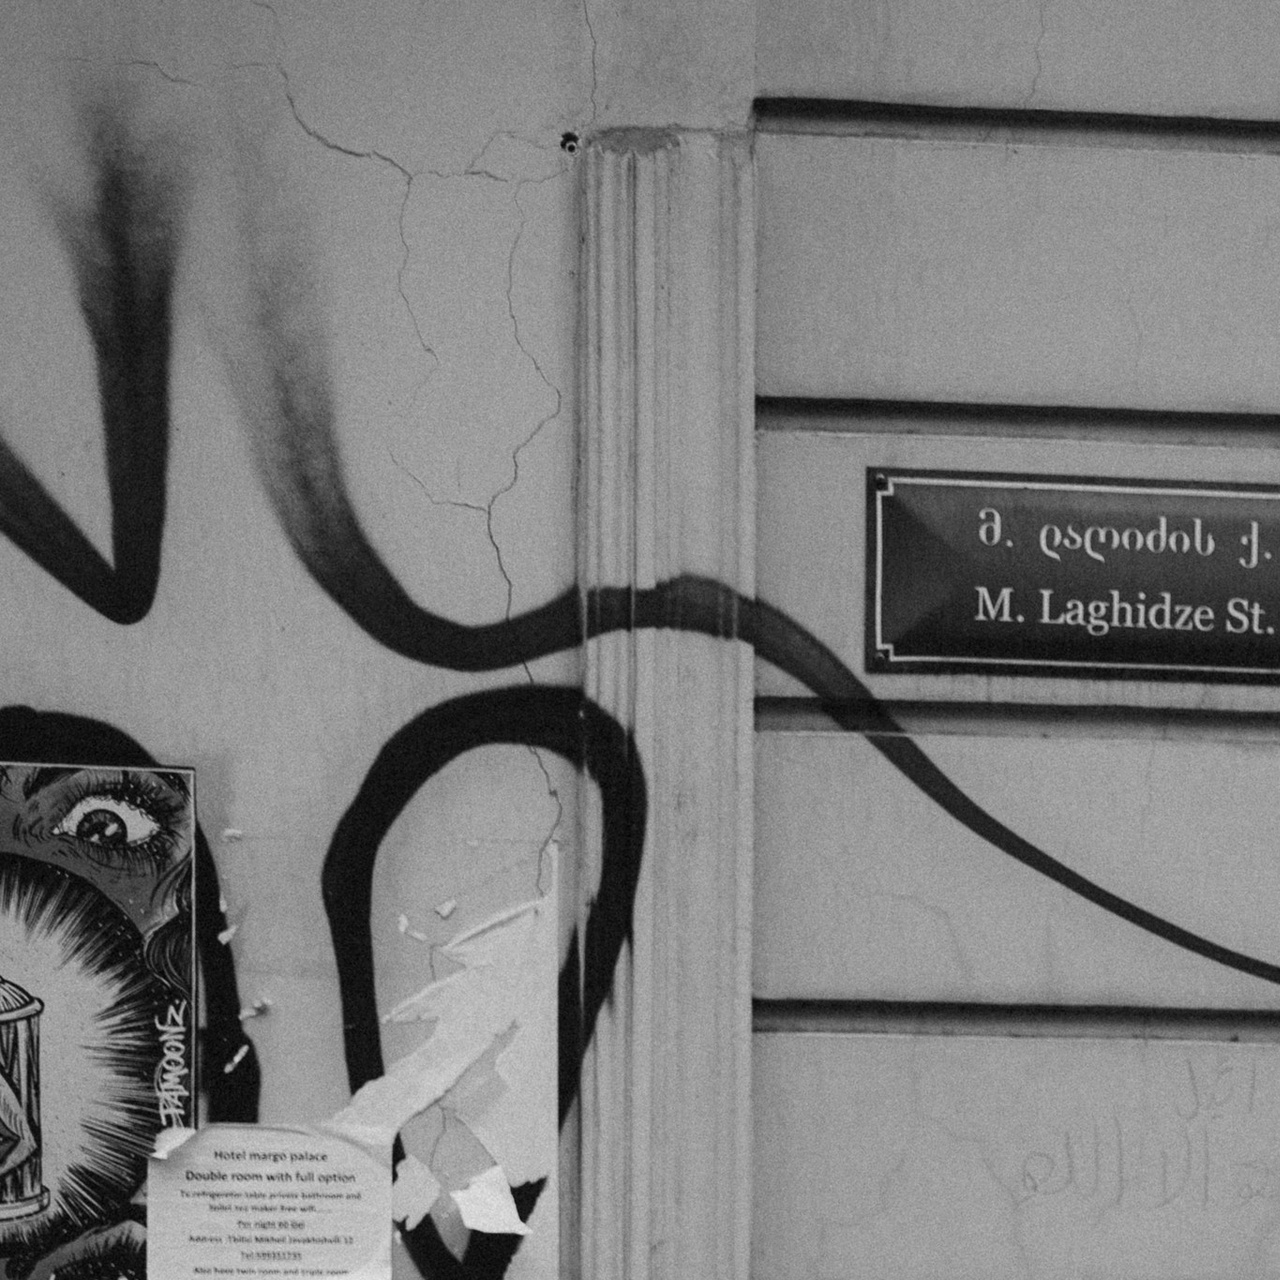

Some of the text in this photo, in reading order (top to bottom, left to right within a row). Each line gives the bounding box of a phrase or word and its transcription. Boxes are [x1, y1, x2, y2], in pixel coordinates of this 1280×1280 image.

[978, 506, 1014, 548] მ.
[1238, 520, 1273, 569] ქ.
[974, 586, 1276, 636] M. Laghidze St.
[215, 1151, 328, 1162] Hotel margo palace
[186, 1170, 356, 1184] Double room with full option
